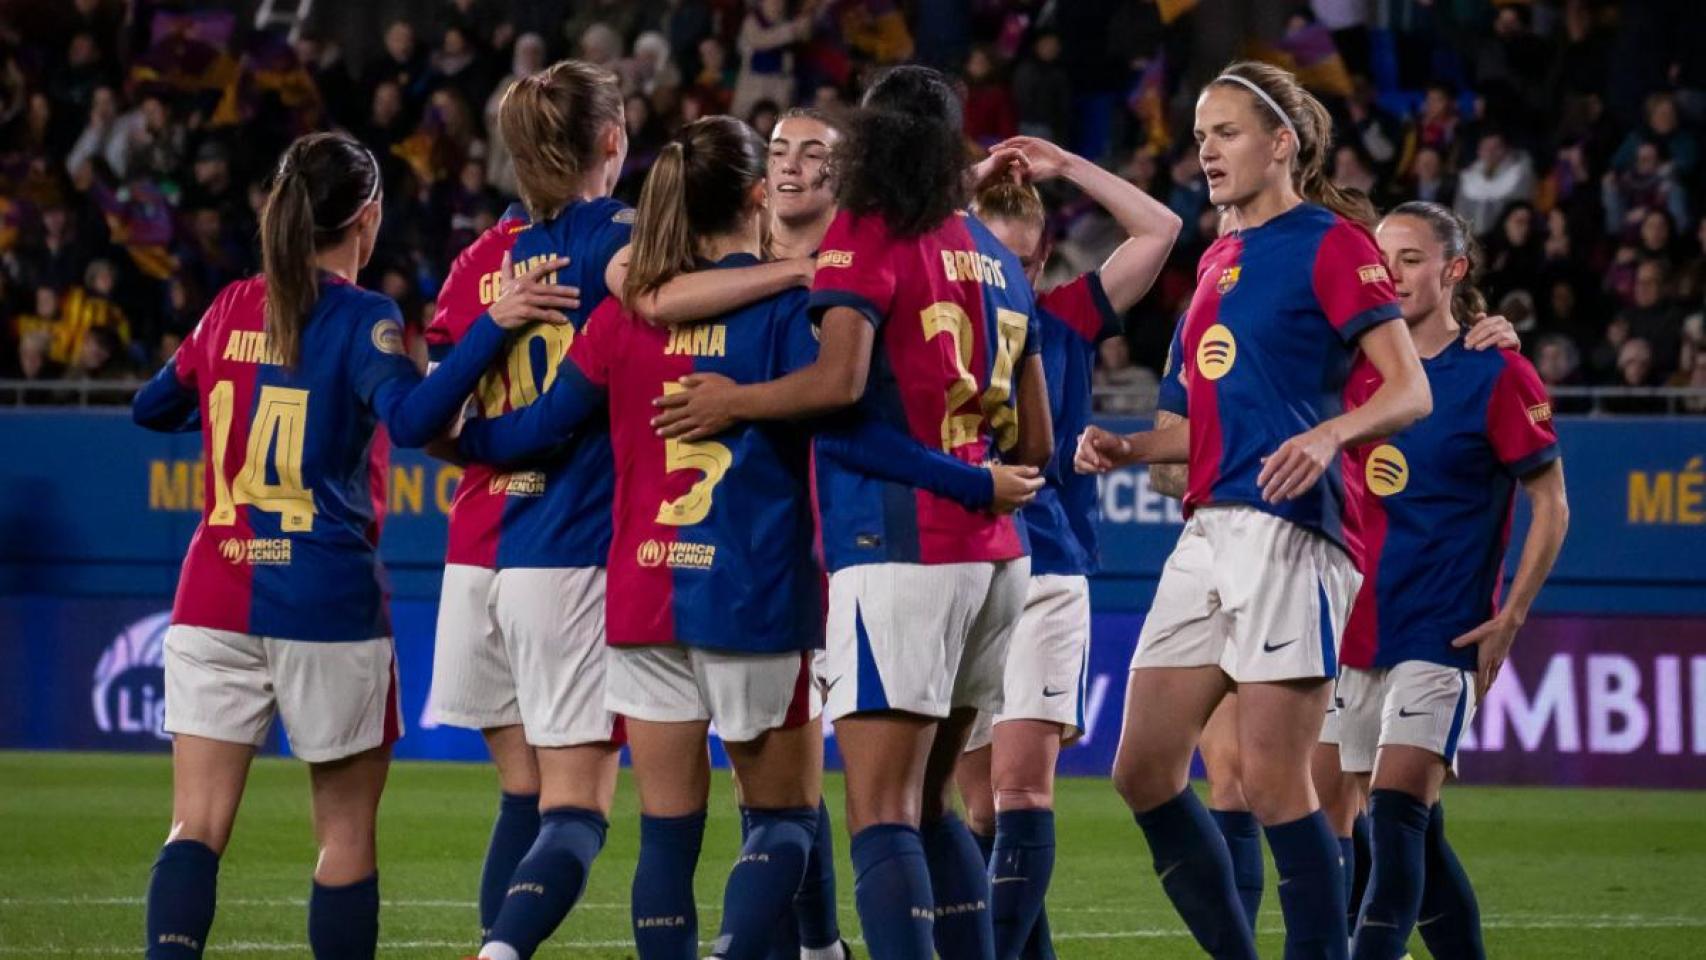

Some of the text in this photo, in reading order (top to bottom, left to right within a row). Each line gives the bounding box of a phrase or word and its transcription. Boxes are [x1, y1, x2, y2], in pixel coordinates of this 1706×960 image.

[664, 324, 726, 357] JANA
[920, 302, 1028, 453] 24
[208, 380, 319, 532] 14
[654, 381, 733, 526] 5
[666, 552, 713, 566] ACNUR
[667, 541, 716, 556] UNHCR
[1456, 652, 1706, 754] MBI
